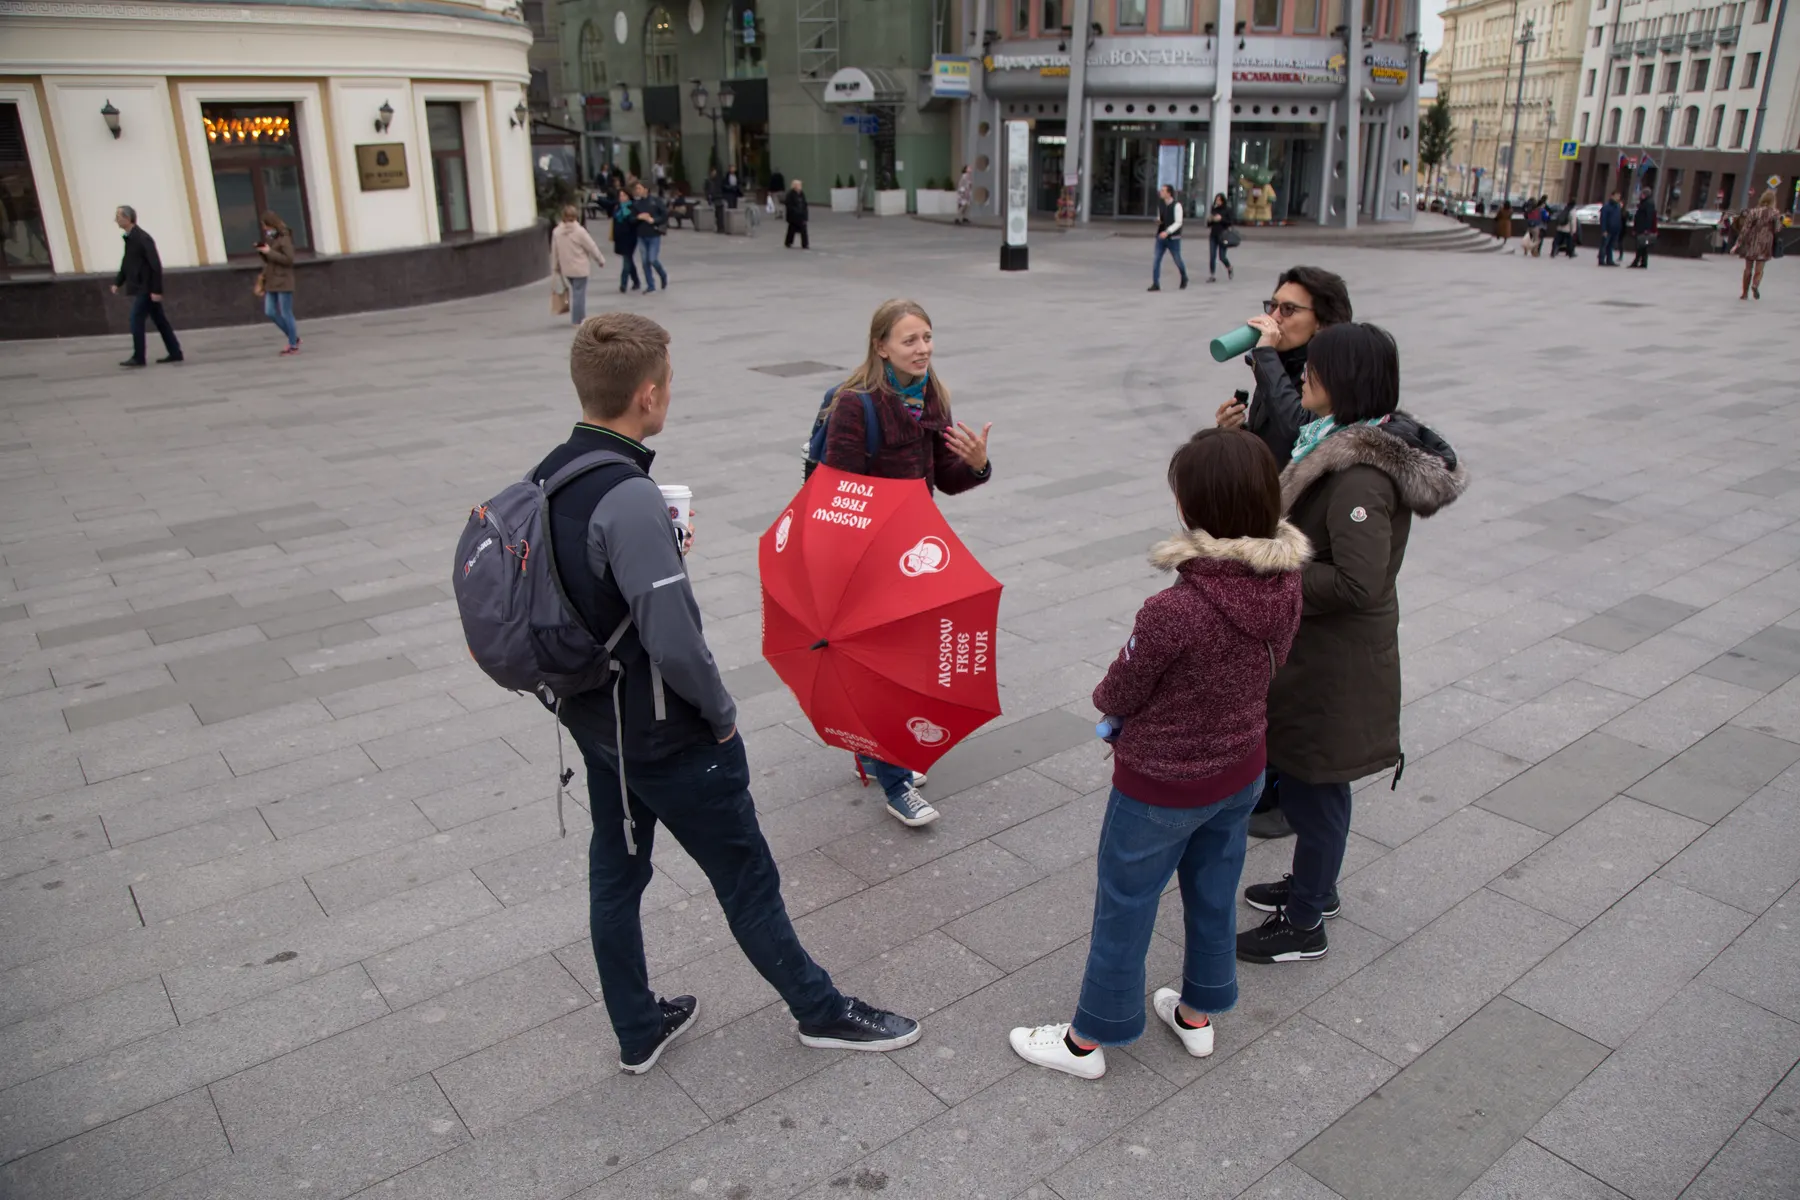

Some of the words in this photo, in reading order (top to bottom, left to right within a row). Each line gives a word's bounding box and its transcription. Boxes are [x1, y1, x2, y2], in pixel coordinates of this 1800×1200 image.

[1110, 49, 1149, 66] BON
[1160, 49, 1192, 65] APP
[1232, 71, 1301, 83] КАСАБЛАНКА
[837, 480, 874, 497] TOUR
[831, 495, 868, 512] FREE
[812, 507, 872, 530] MOSCOW
[938, 618, 953, 688] MOSCOW
[956, 632, 970, 674] FREE
[973, 630, 989, 675] TOUR
